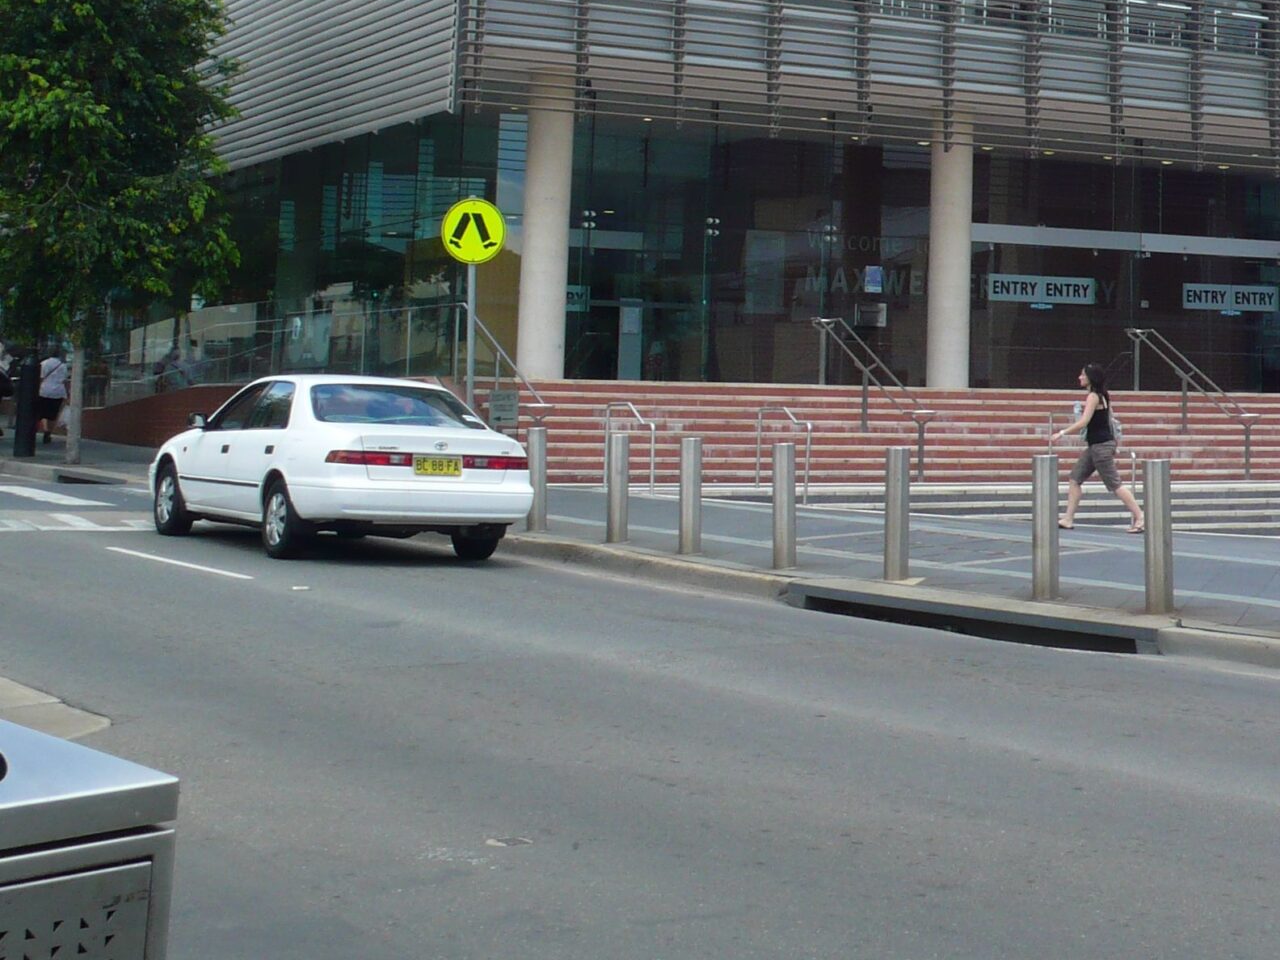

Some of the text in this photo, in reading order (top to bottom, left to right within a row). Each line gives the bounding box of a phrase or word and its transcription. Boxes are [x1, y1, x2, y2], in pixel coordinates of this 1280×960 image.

[992, 279, 1038, 296] ENTRY
[1046, 282, 1090, 298] ENTRY
[1186, 289, 1275, 305] ENTRY ENTRY
